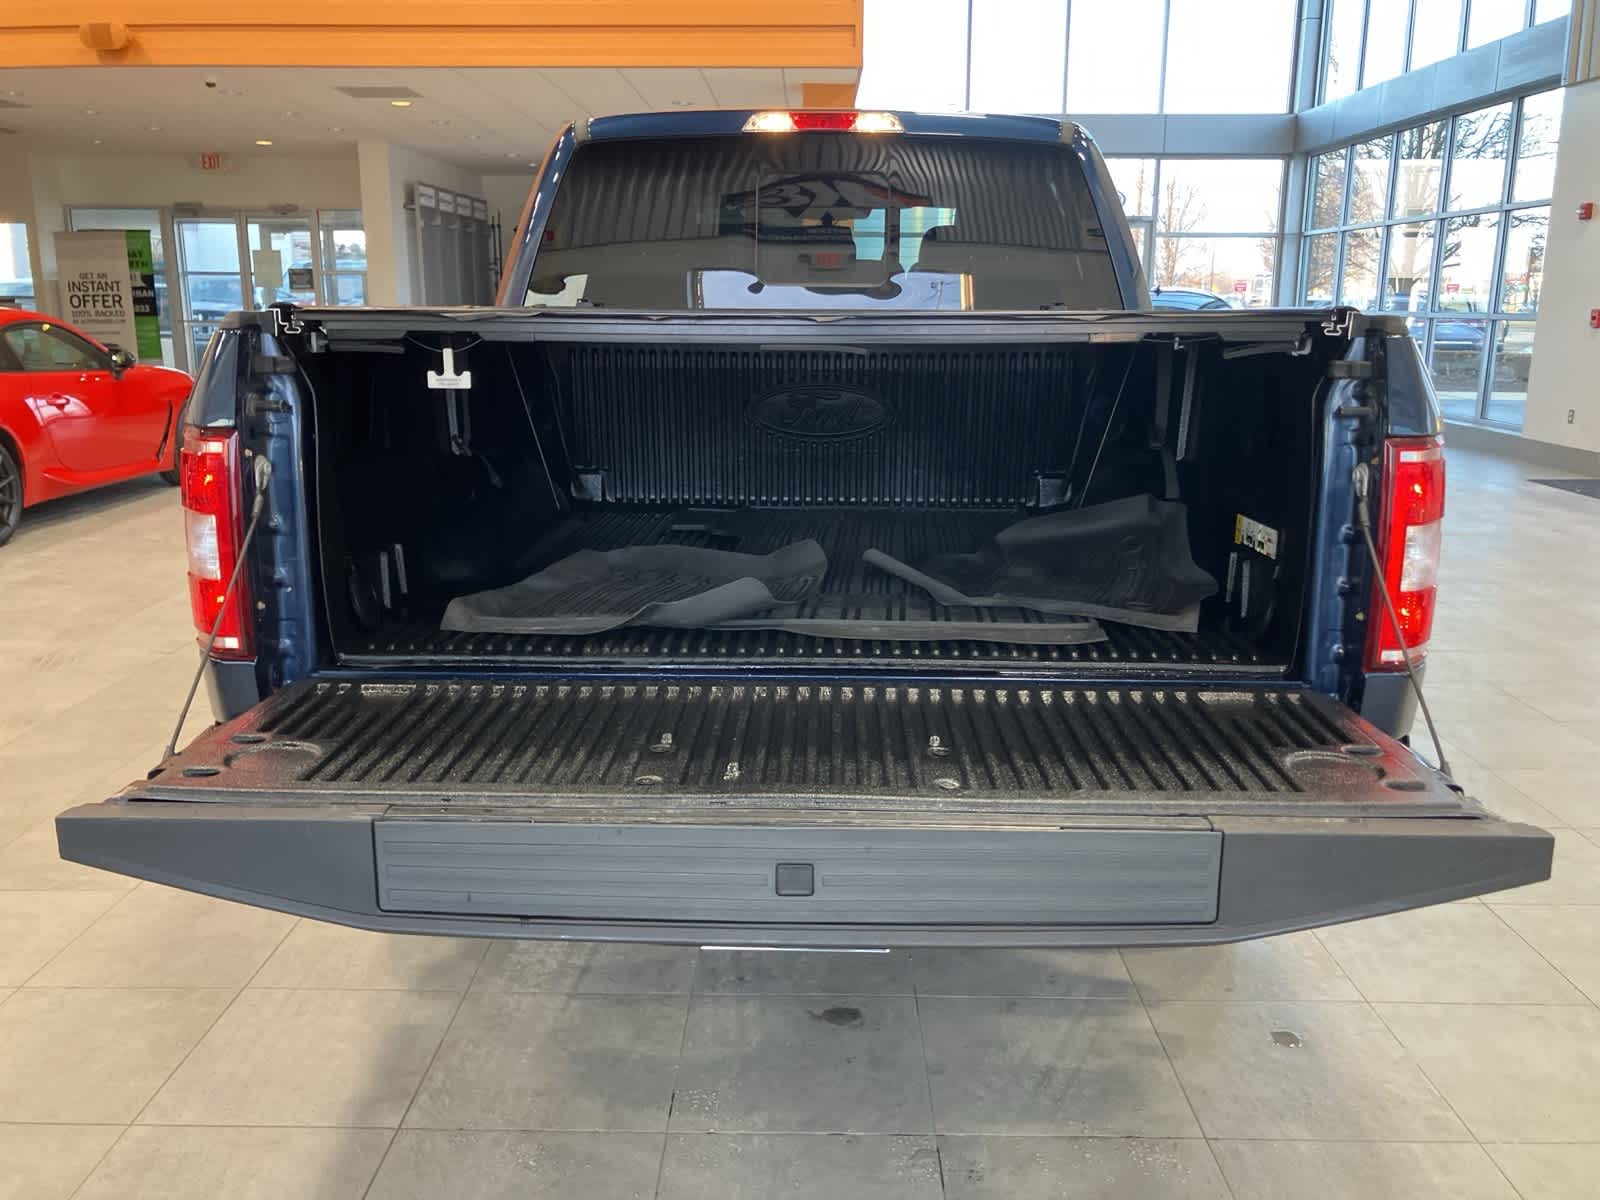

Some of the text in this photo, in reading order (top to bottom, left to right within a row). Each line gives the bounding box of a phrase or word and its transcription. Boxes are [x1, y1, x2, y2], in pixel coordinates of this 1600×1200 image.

[201, 153, 220, 169] EXIT
[79, 272, 94, 280] GET
[68, 280, 121, 293] INSTANT
[69, 294, 123, 309] OFFER
[778, 393, 862, 428] Ford
